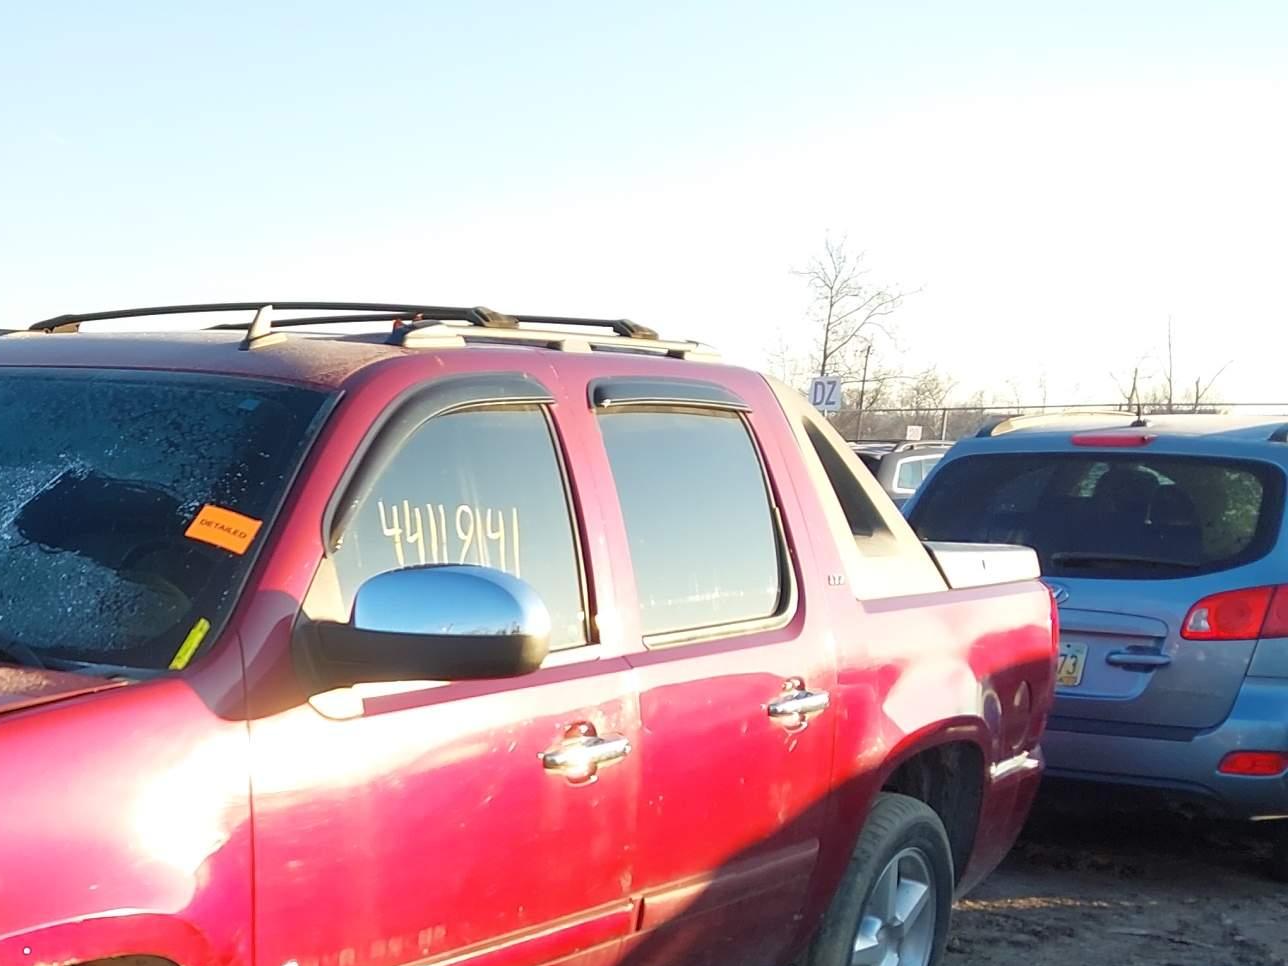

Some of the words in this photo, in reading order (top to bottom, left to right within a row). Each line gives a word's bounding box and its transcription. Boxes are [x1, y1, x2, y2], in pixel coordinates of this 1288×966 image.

[812, 380, 837, 406] DZ
[199, 518, 248, 540] DETAILED
[377, 499, 521, 579] 44119141
